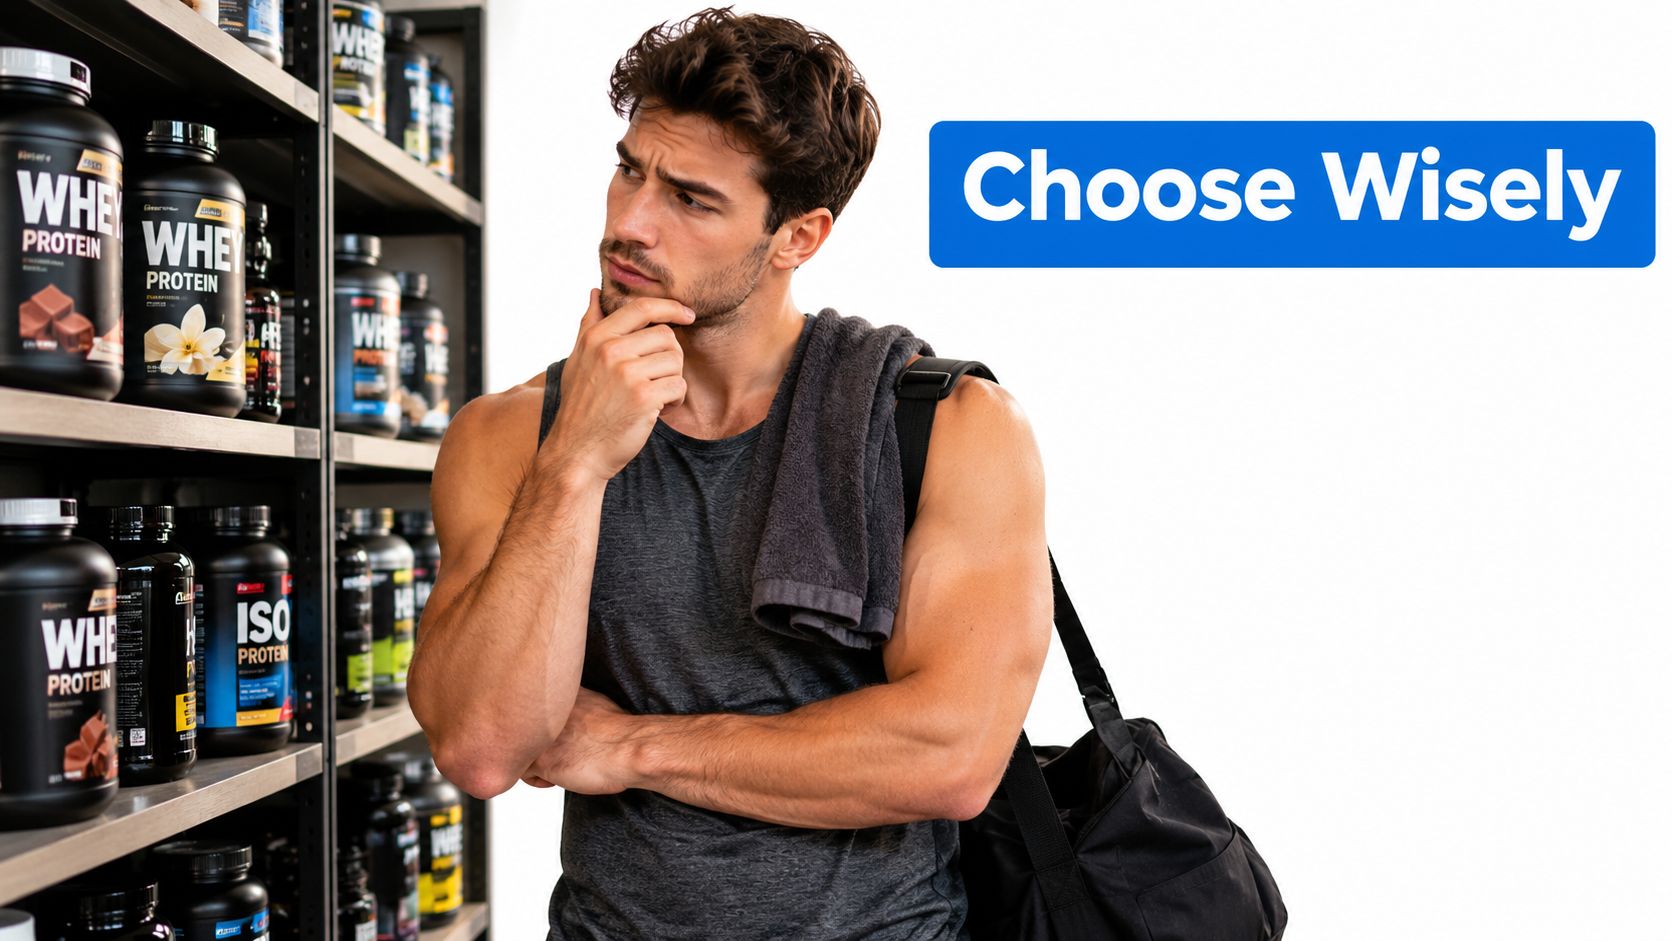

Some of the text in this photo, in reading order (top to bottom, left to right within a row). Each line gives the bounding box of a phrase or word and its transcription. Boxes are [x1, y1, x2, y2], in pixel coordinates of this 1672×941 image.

[17, 170, 122, 239] WHEY
[22, 229, 101, 260] PROTEIN
[142, 220, 244, 274] WHEY
[146, 271, 219, 293] PROTEIN
[41, 614, 118, 670] WHE
[237, 599, 290, 644] ISO
[47, 668, 111, 696] PROTEIN
